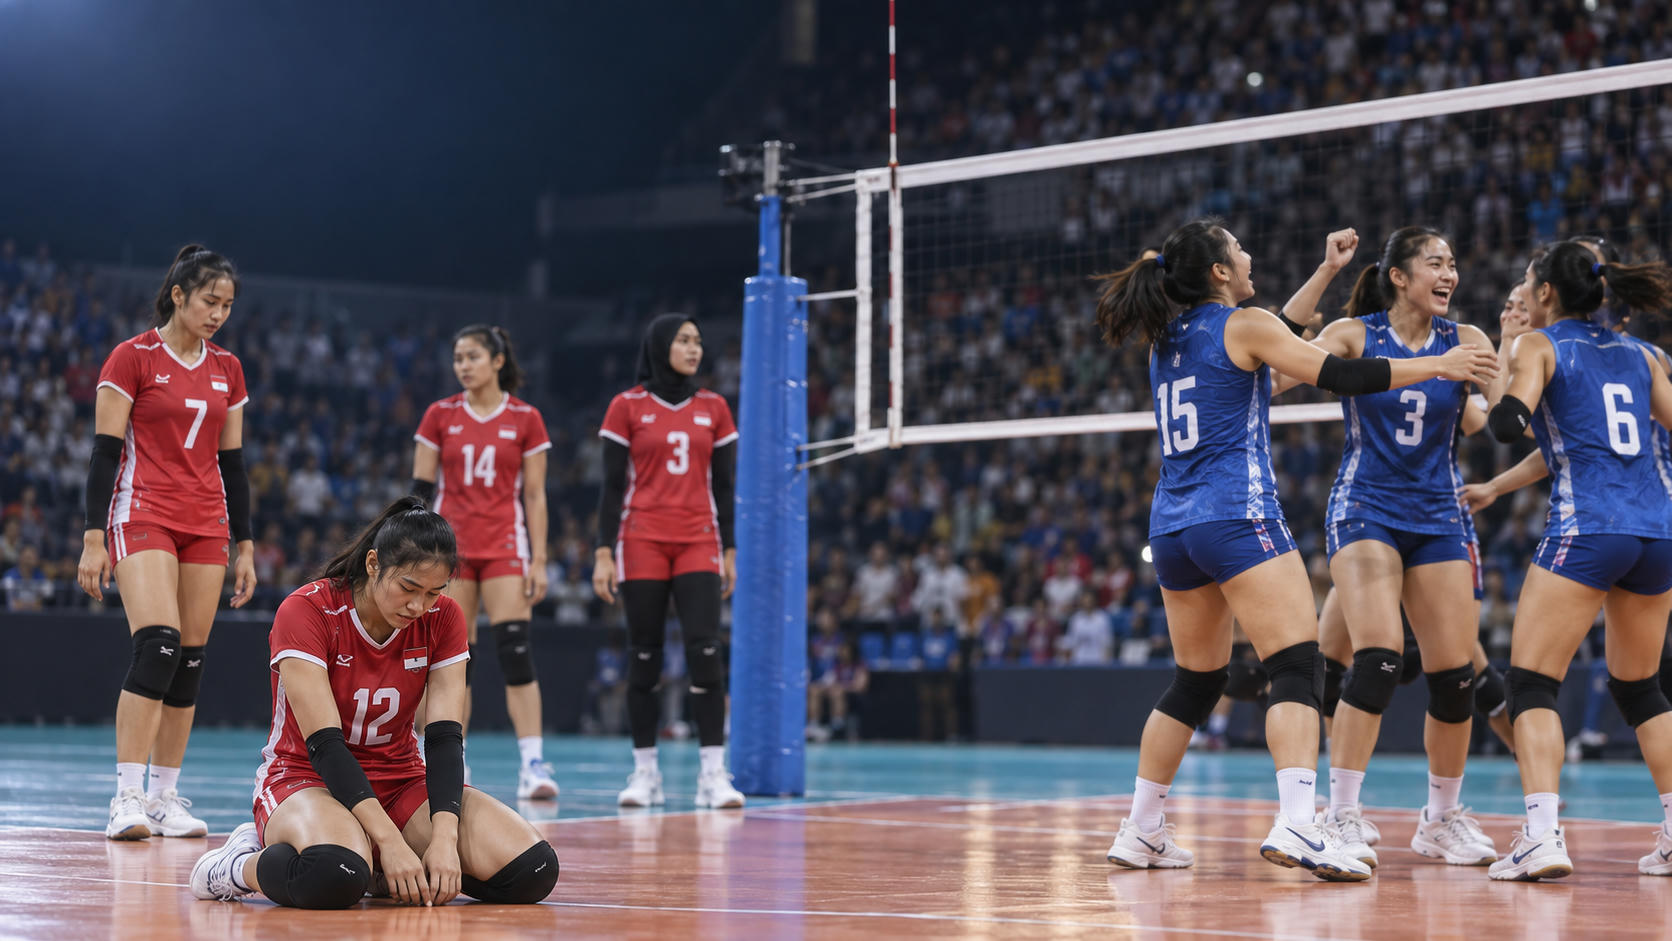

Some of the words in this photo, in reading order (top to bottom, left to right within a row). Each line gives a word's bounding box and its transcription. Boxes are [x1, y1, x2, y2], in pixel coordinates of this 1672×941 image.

[183, 399, 208, 450] 7
[1155, 375, 1200, 457] 15
[1394, 389, 1427, 446] 3
[1601, 382, 1641, 456] 6
[461, 444, 497, 487] 14
[666, 431, 690, 475] 3
[348, 687, 400, 746] 12
